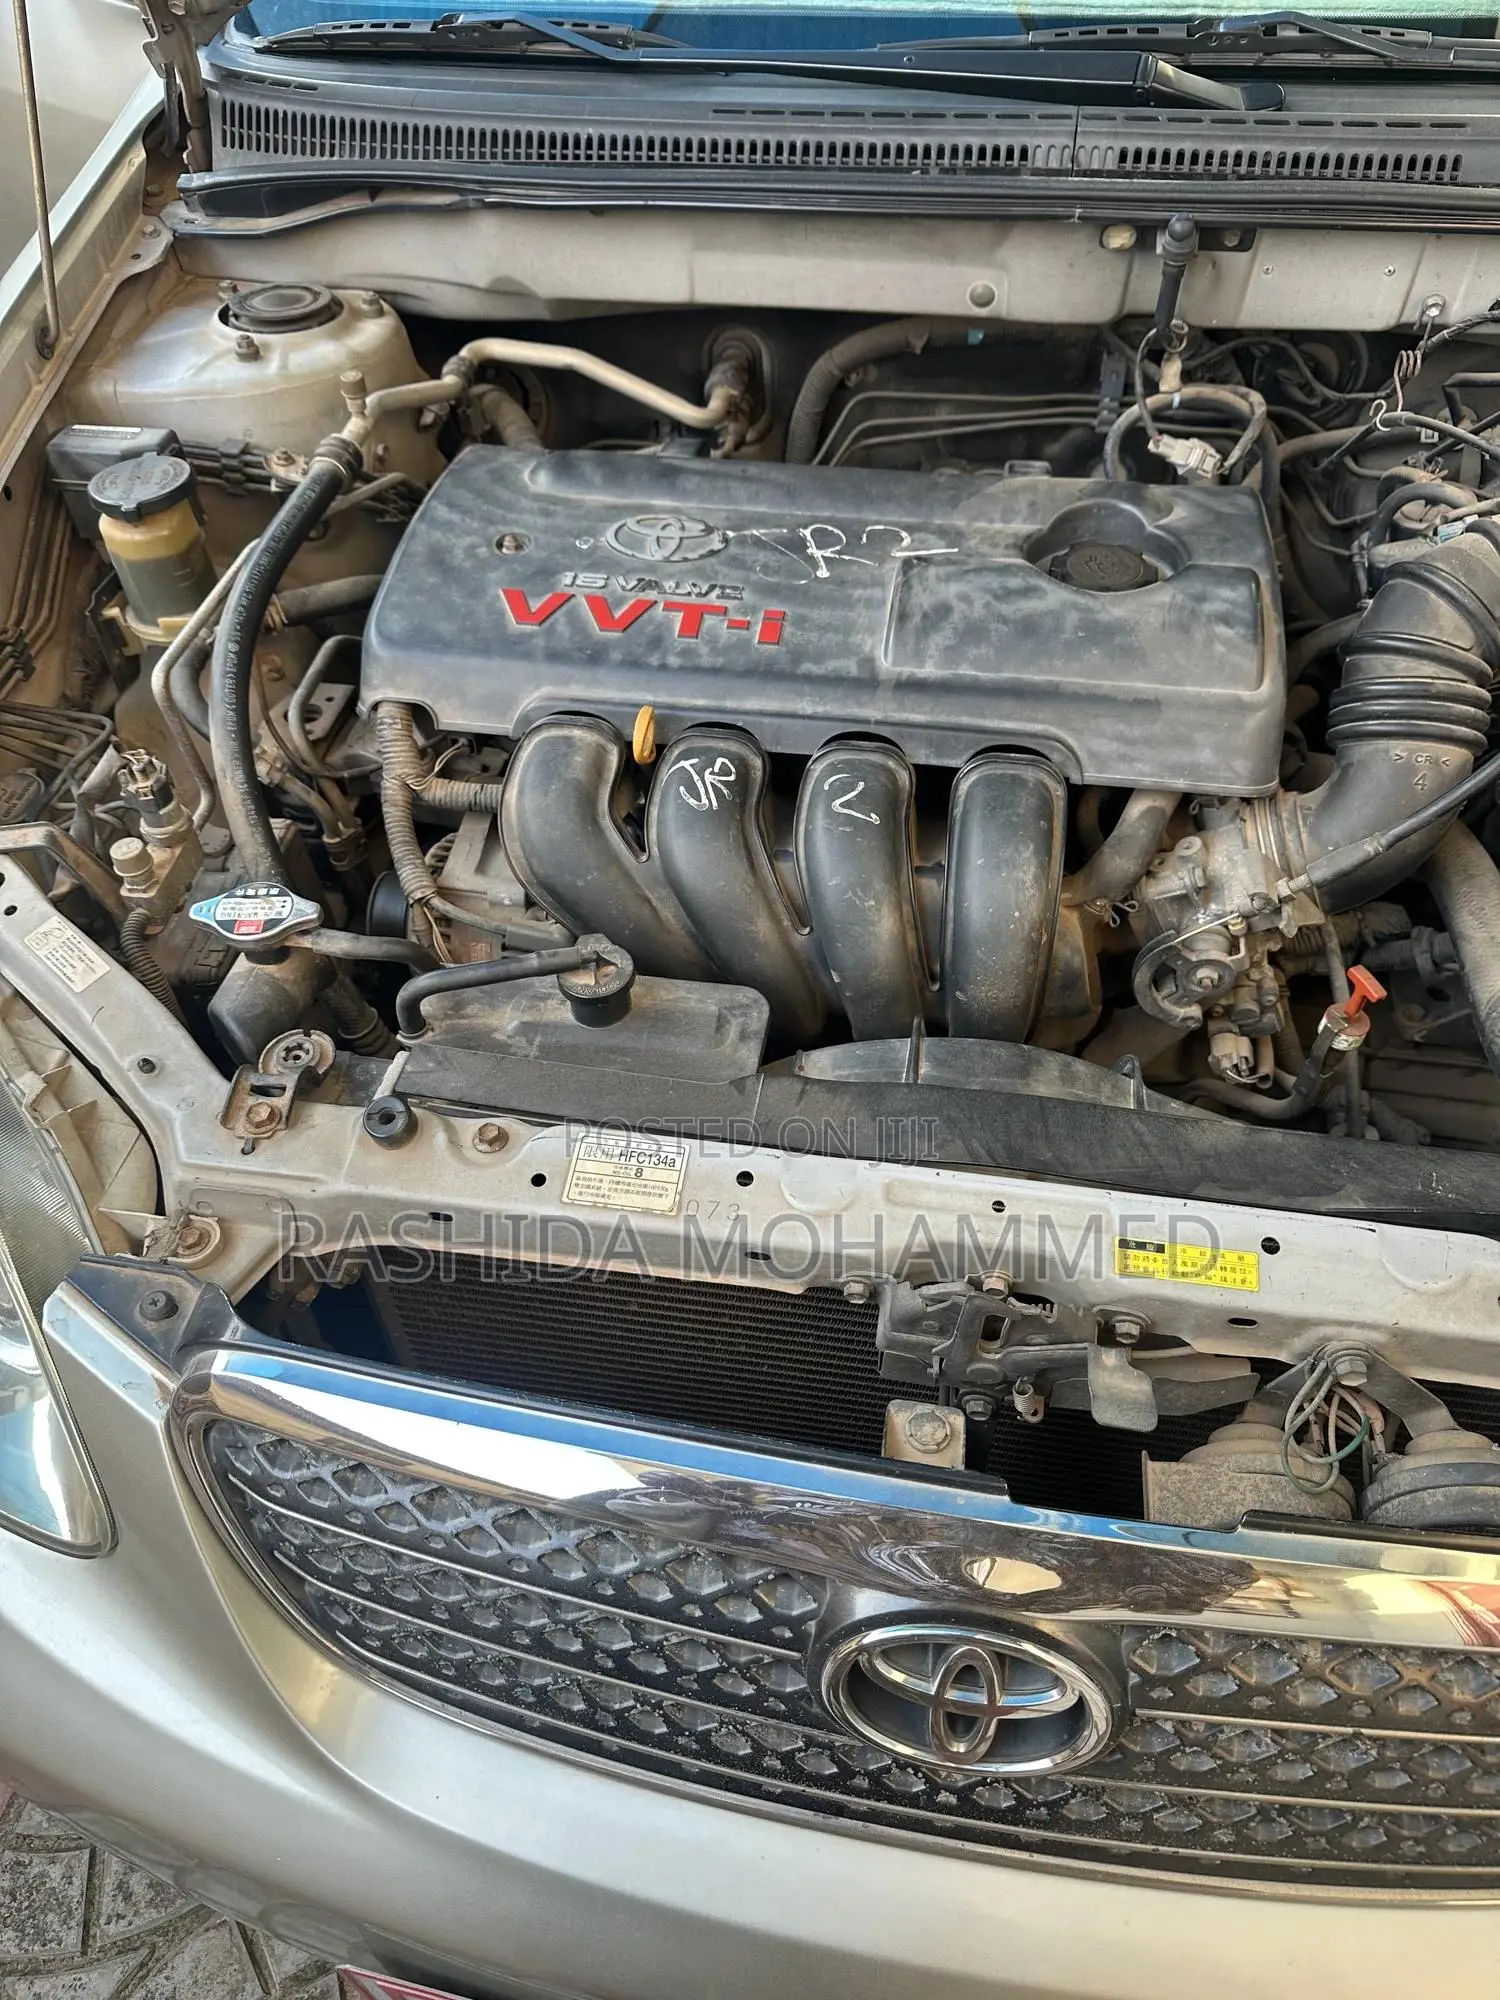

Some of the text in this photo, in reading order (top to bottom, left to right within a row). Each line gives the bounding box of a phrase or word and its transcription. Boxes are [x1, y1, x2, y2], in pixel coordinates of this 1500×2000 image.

[614, 575, 745, 601] VALVE
[500, 587, 791, 646] VVT-i
[1412, 771, 1428, 791] 4
[618, 1150, 677, 1168] HFC134a
[634, 1167, 644, 1178] 8
